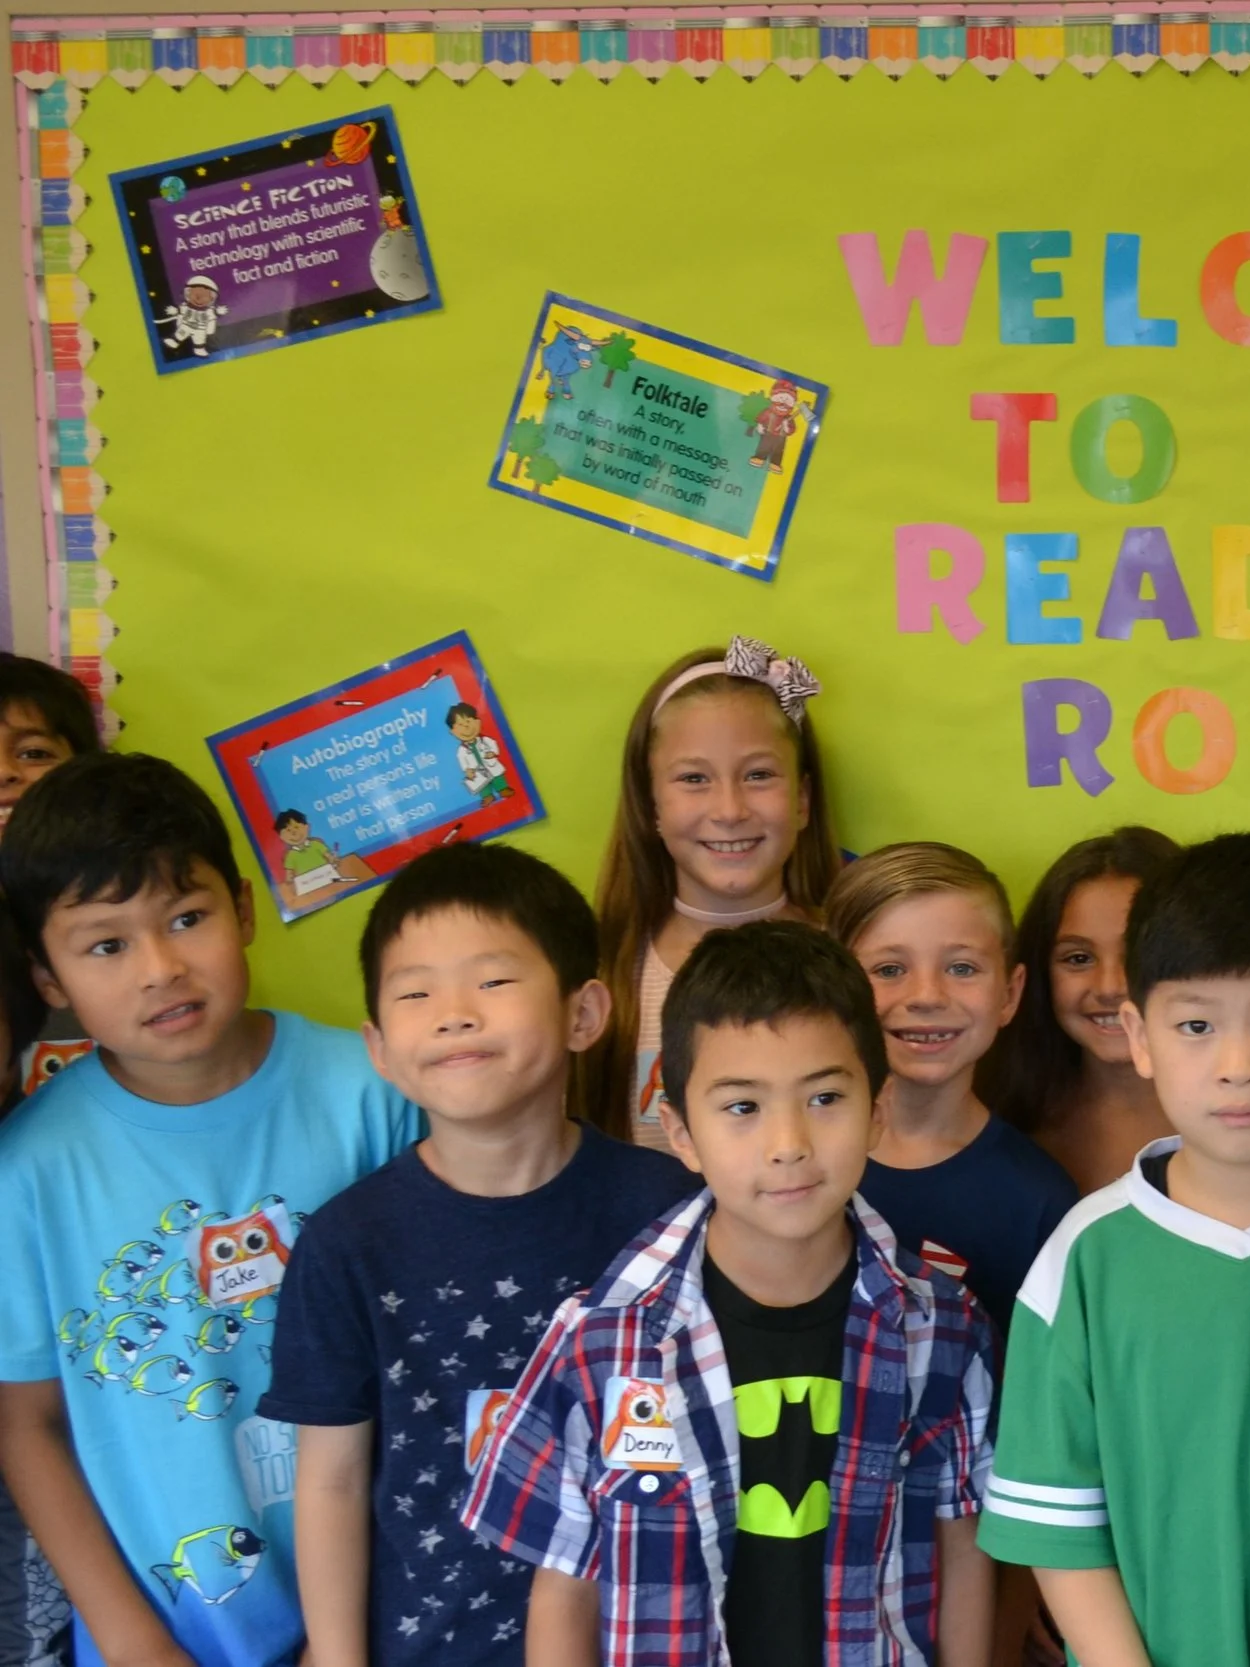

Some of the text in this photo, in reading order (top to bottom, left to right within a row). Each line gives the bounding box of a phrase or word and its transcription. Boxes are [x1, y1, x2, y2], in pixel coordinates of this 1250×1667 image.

[176, 194, 370, 252] A story that blends futuristic
[190, 218, 366, 271] technology with scientific
[233, 249, 339, 284] fact and fiction
[632, 376, 708, 418] Folktale
[634, 405, 645, 419] A
[554, 422, 742, 498] that was initially passed on
[577, 409, 730, 472] often with a message,
[970, 392, 1176, 504] TO
[583, 454, 707, 507] by word of mouth
[292, 708, 427, 774] Autobiography
[326, 739, 407, 782] The story of
[313, 752, 437, 811] a real person's life
[327, 776, 440, 829] that is written by
[355, 802, 436, 841] that person
[216, 1266, 259, 1293] Jake
[624, 1432, 674, 1459] Denny
